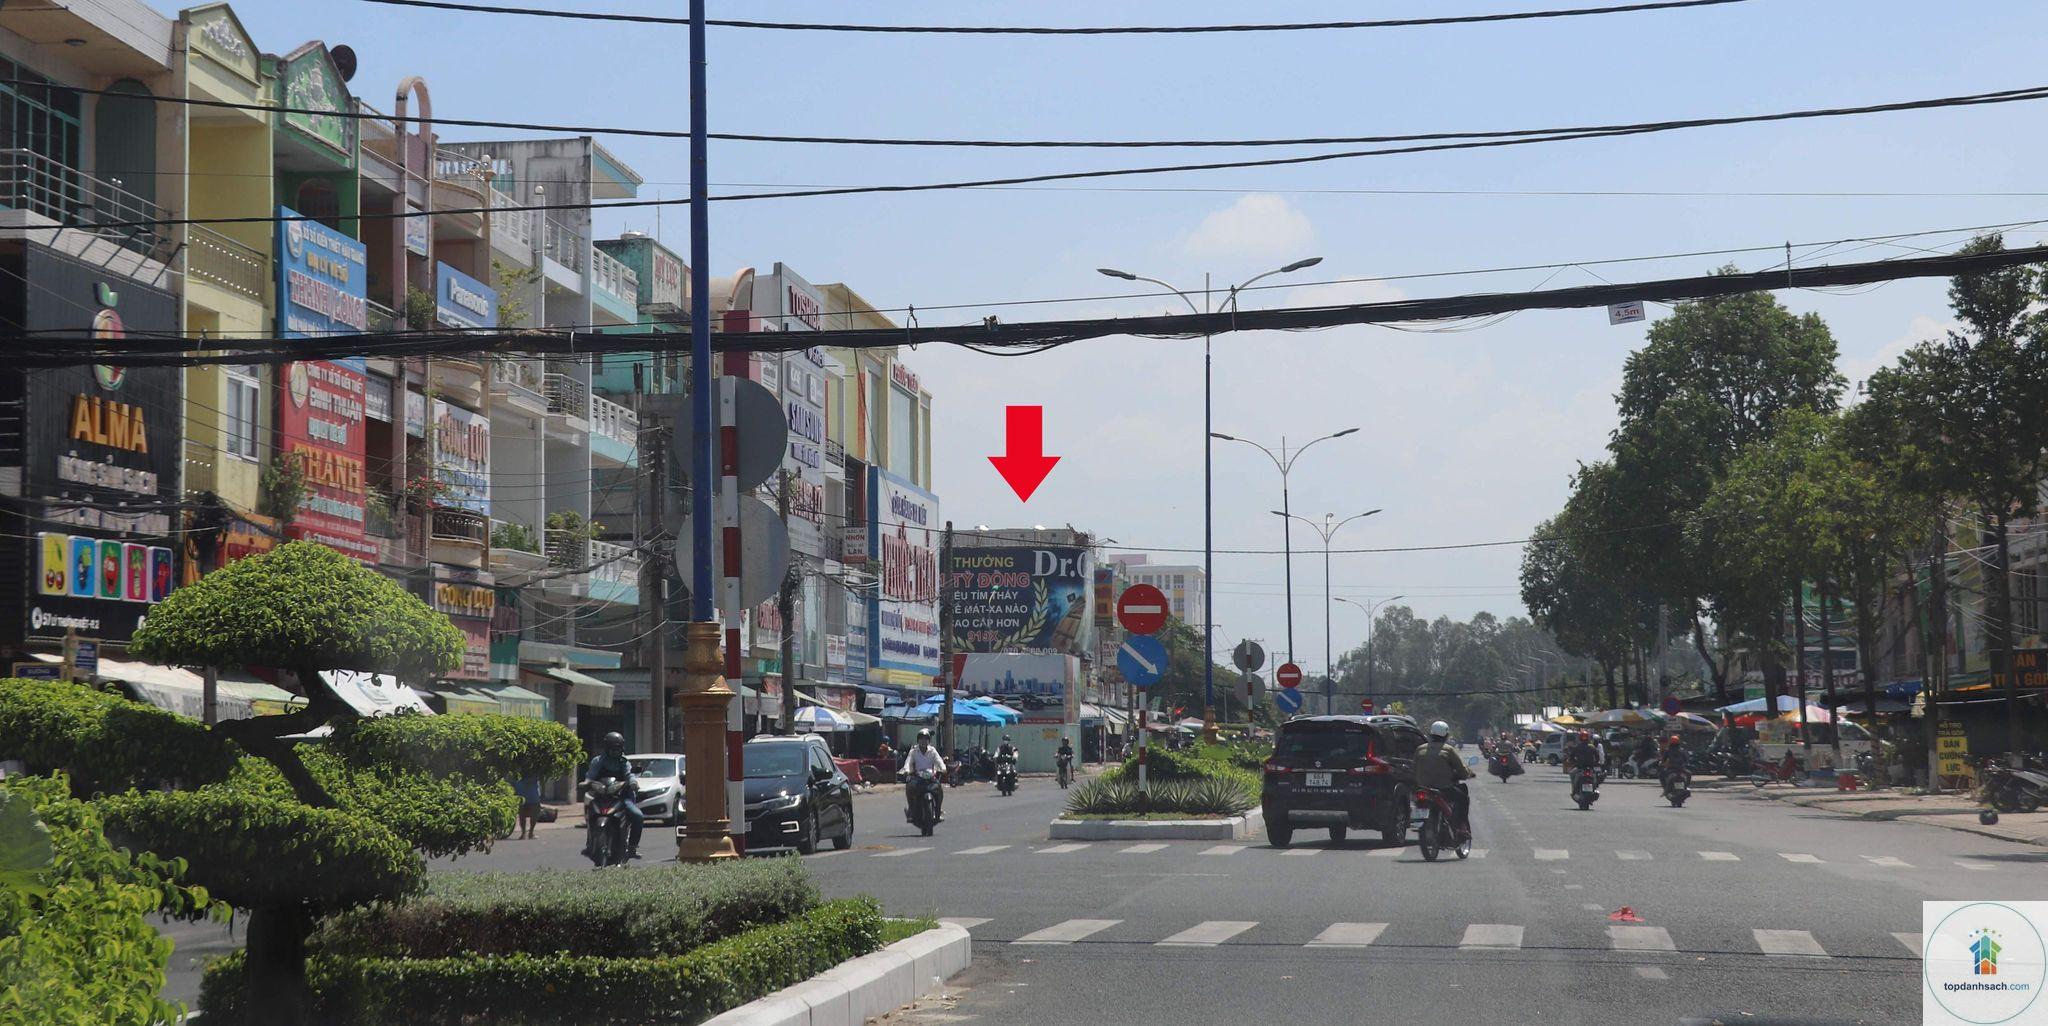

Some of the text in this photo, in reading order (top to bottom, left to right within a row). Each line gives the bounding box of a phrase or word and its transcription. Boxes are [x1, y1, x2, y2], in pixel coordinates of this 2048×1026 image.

[70, 392, 148, 454] ALMA
[789, 402, 822, 445] SAMSUNG
[977, 569, 1031, 588] ĐỒNG
